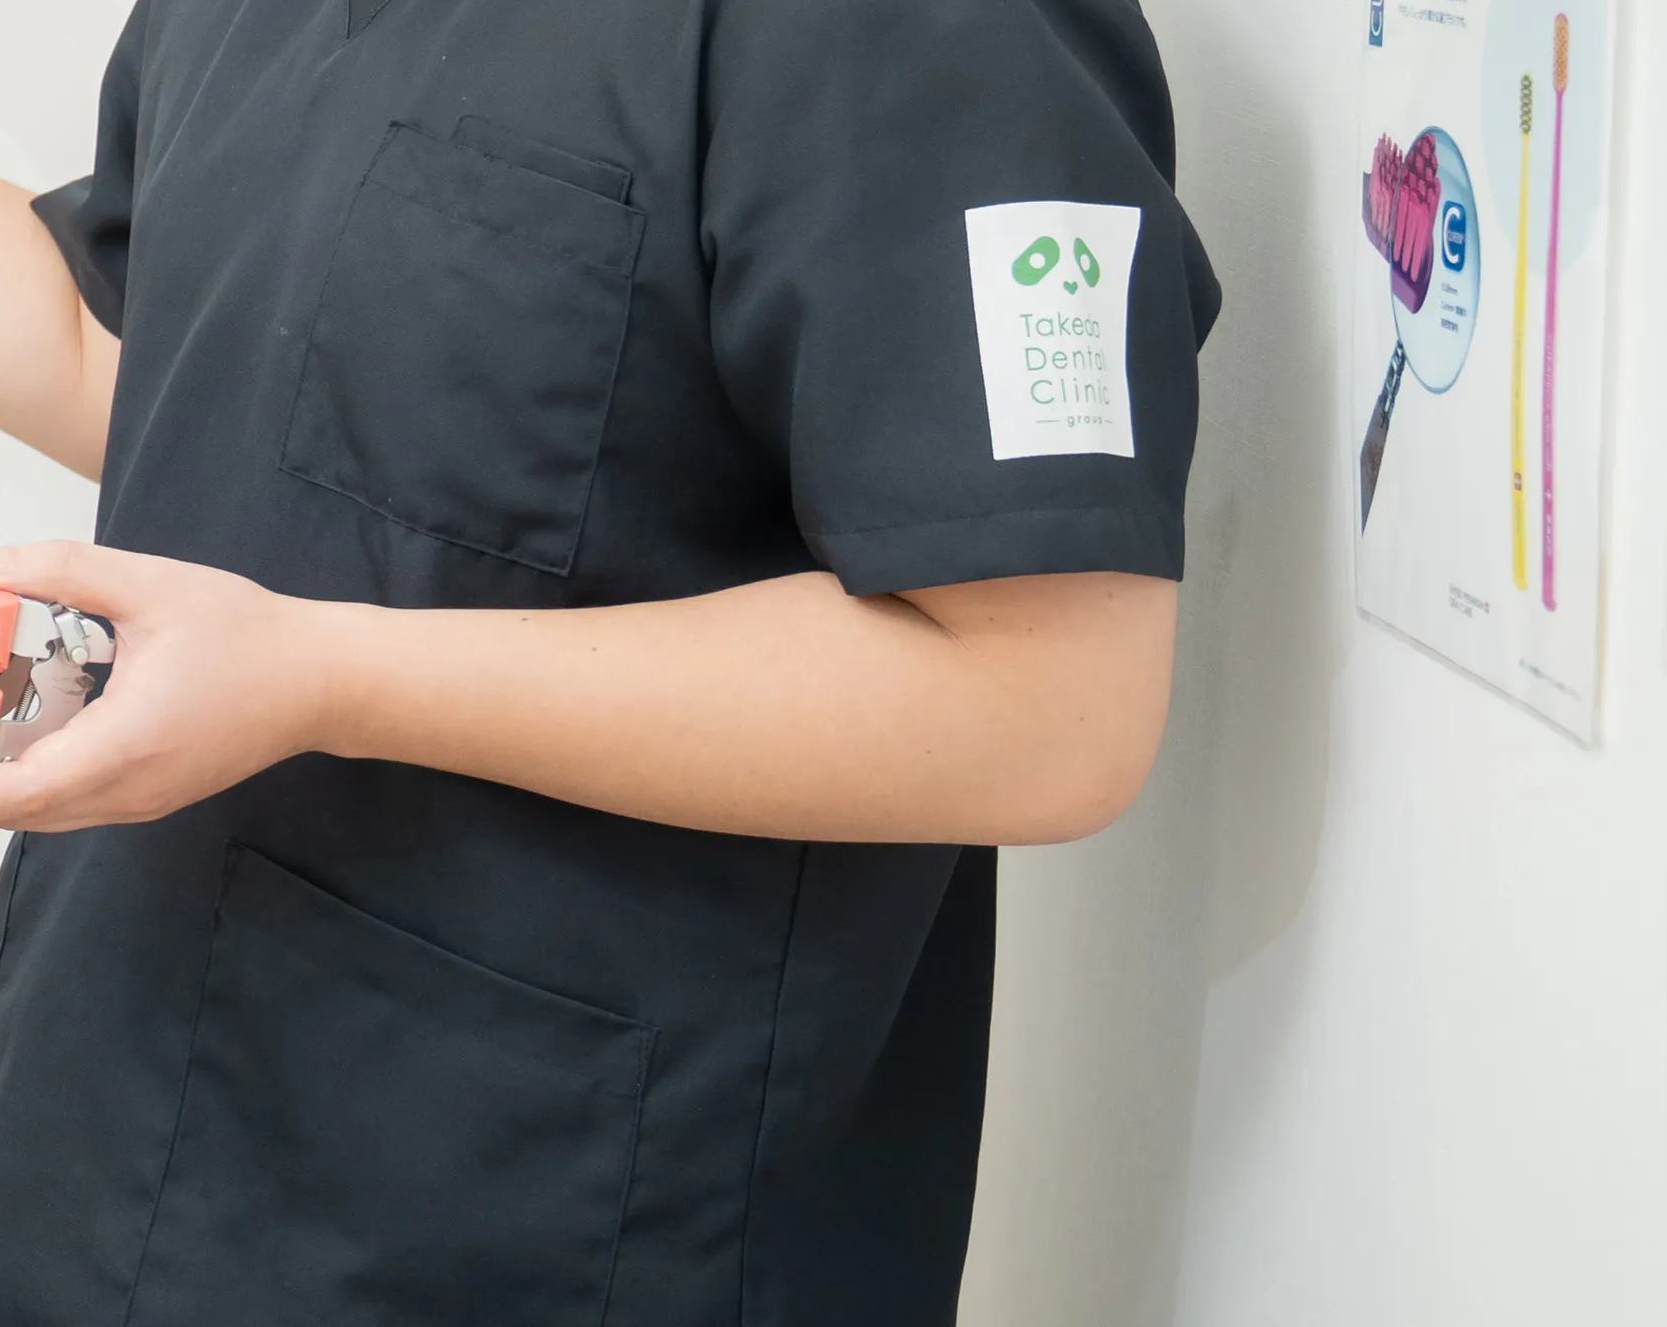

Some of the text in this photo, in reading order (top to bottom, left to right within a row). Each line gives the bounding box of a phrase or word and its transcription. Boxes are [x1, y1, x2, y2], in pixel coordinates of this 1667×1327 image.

[1019, 312, 1100, 338] Takeda
[1025, 346, 1106, 371] Dental
[1030, 378, 1110, 404] Clinic
